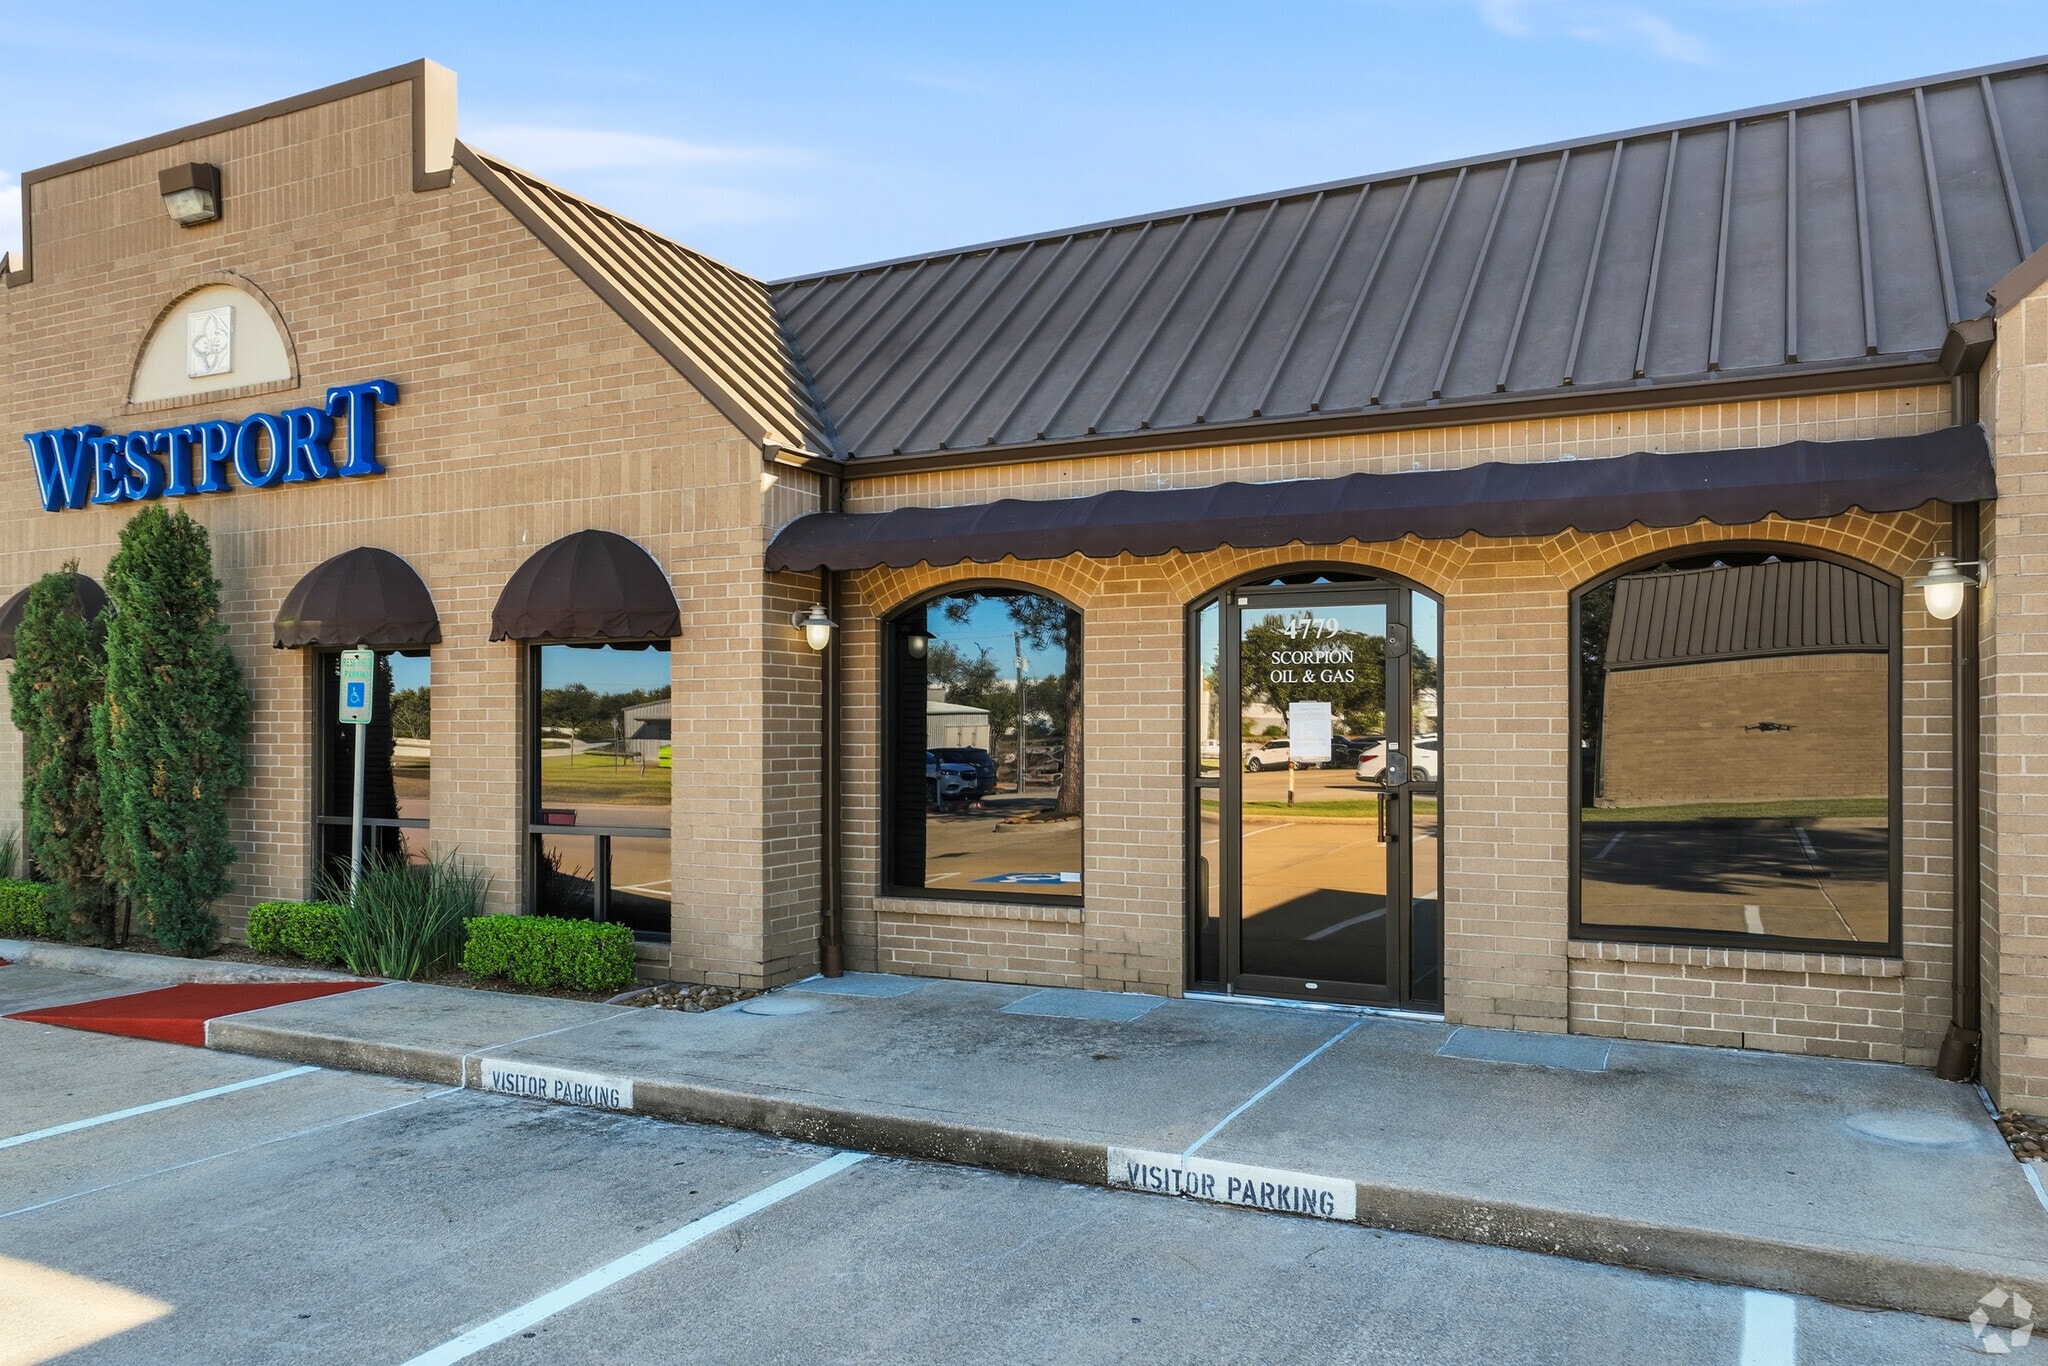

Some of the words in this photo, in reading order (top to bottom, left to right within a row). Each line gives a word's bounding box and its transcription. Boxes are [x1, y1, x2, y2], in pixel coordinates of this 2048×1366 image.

[23, 379, 398, 512] WESTPORT
[1284, 617, 1339, 639] 4779
[1271, 650, 1354, 665] SCORPION
[1270, 669, 1298, 683] OIL
[1302, 669, 1316, 683] &
[1320, 669, 1355, 683] GAS
[492, 1070, 548, 1098] VISITOR
[554, 1079, 620, 1109] PARKING
[1127, 1162, 1215, 1198] VISITOR
[1227, 1176, 1335, 1216] PARKING
